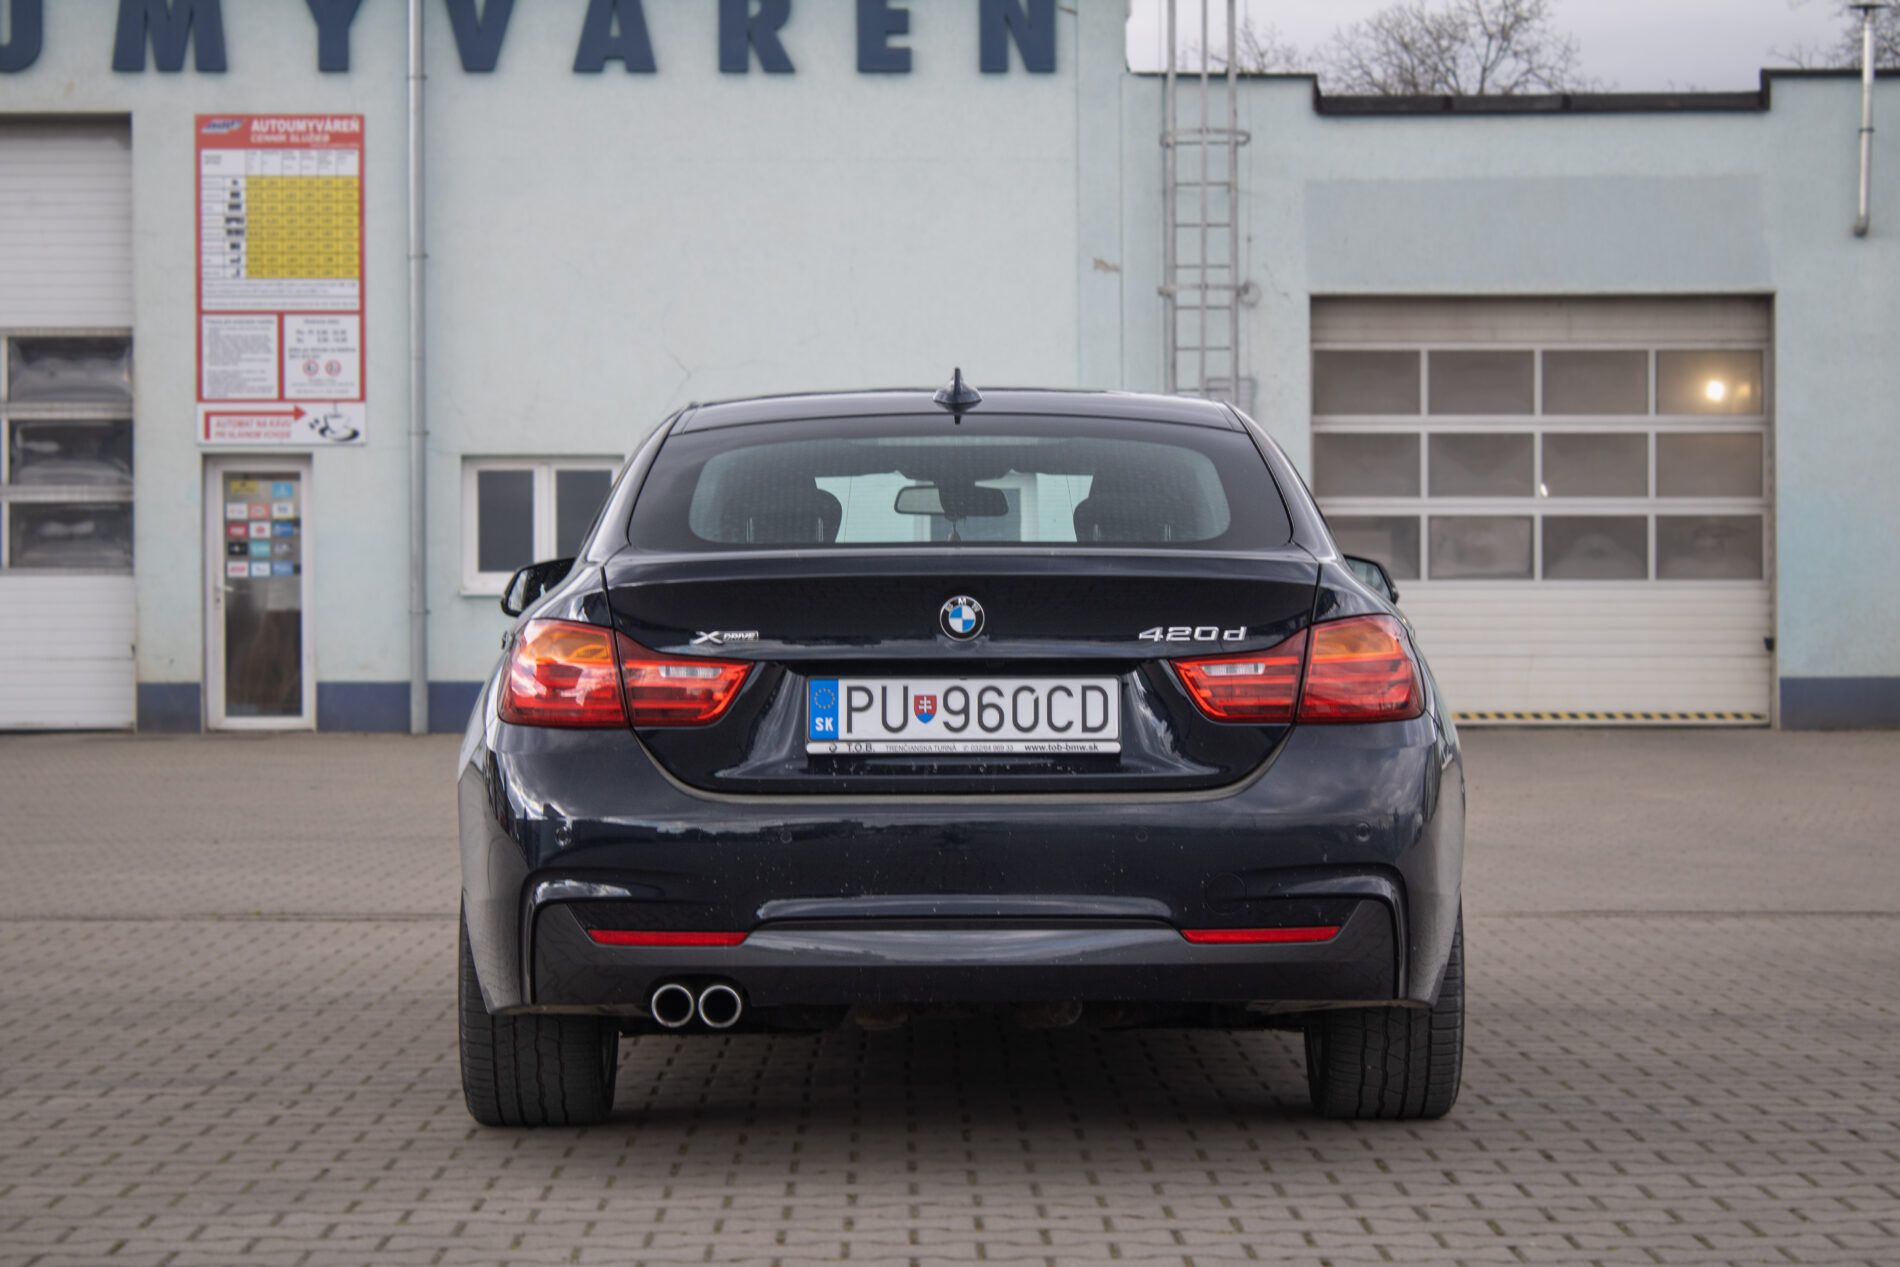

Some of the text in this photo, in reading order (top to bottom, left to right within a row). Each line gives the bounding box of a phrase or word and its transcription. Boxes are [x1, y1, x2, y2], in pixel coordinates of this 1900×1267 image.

[1138, 626, 1247, 642] 420d
[815, 717, 834, 732] SK
[1024, 742, 1100, 752] www.tob-bmw.sk
